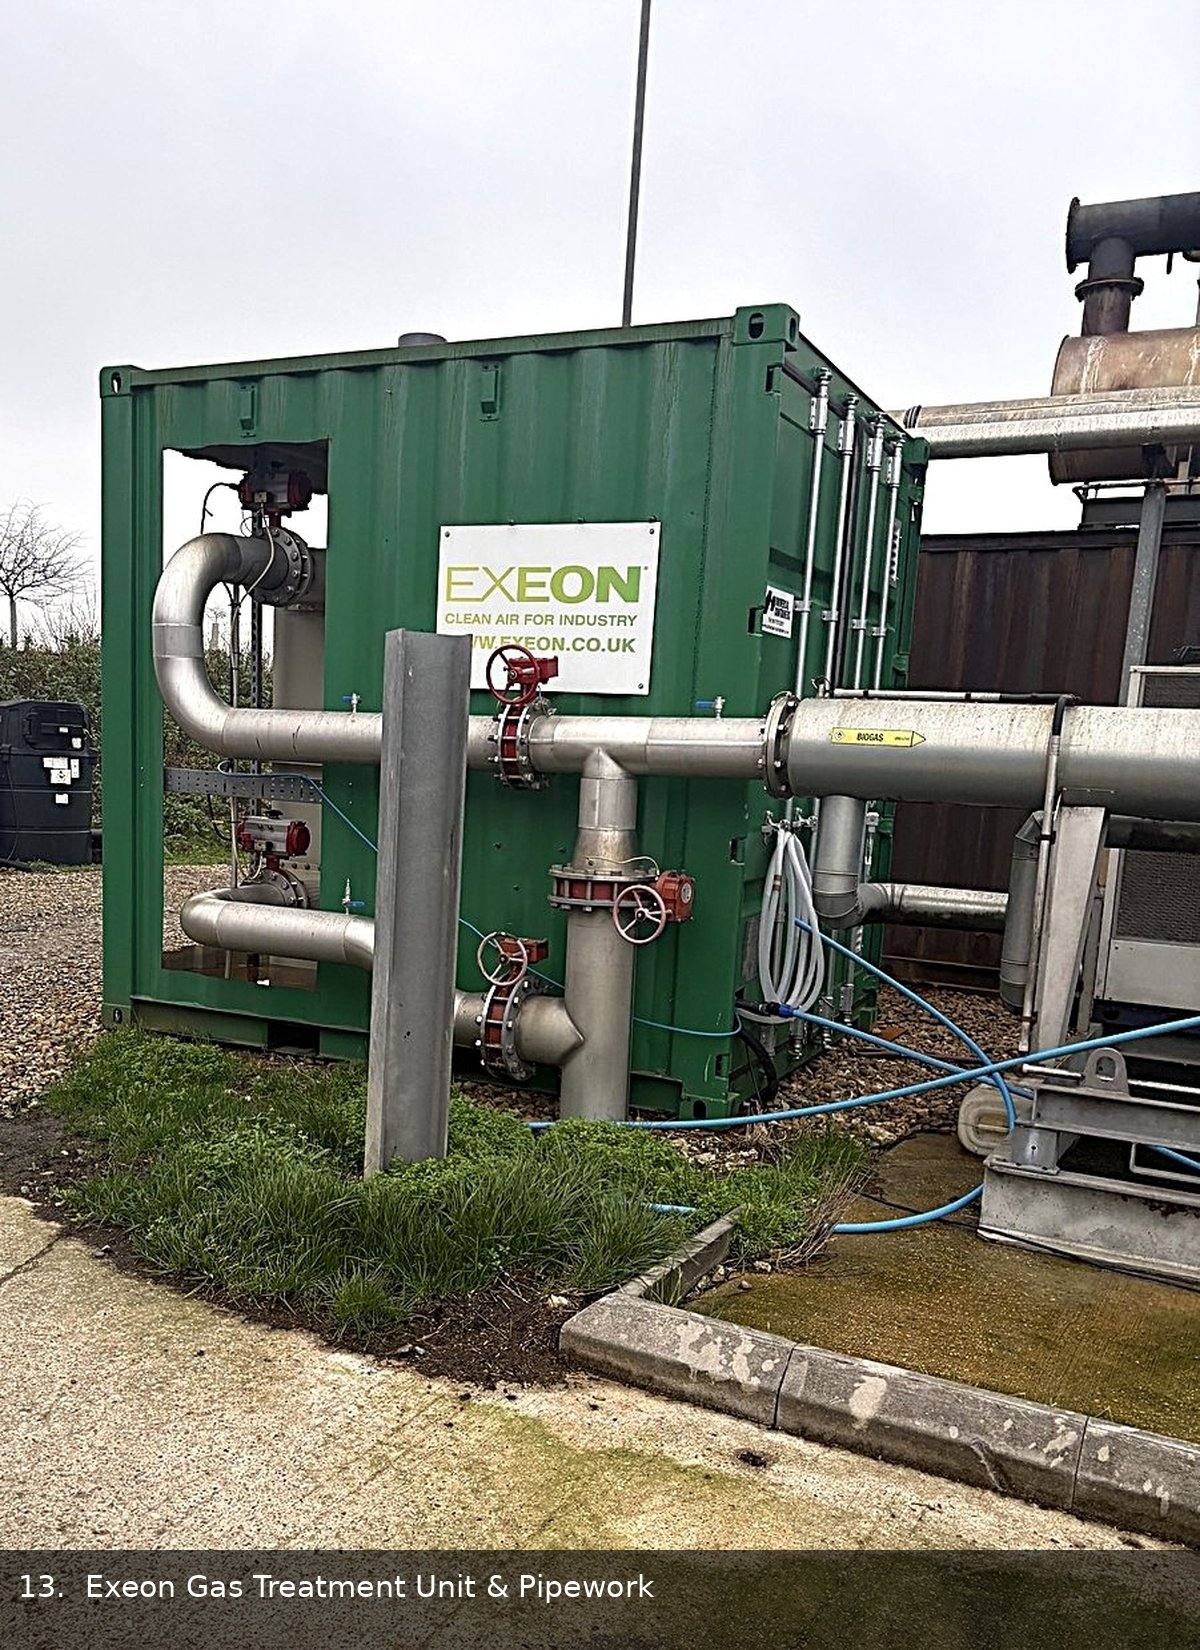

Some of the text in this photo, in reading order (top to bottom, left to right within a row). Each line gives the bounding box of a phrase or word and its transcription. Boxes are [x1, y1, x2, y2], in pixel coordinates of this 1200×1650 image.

[446, 565, 641, 604] EXEON
[445, 613, 637, 627] CLEAN AIR FOR INDUSTRY
[856, 732, 884, 742] BIOGAS
